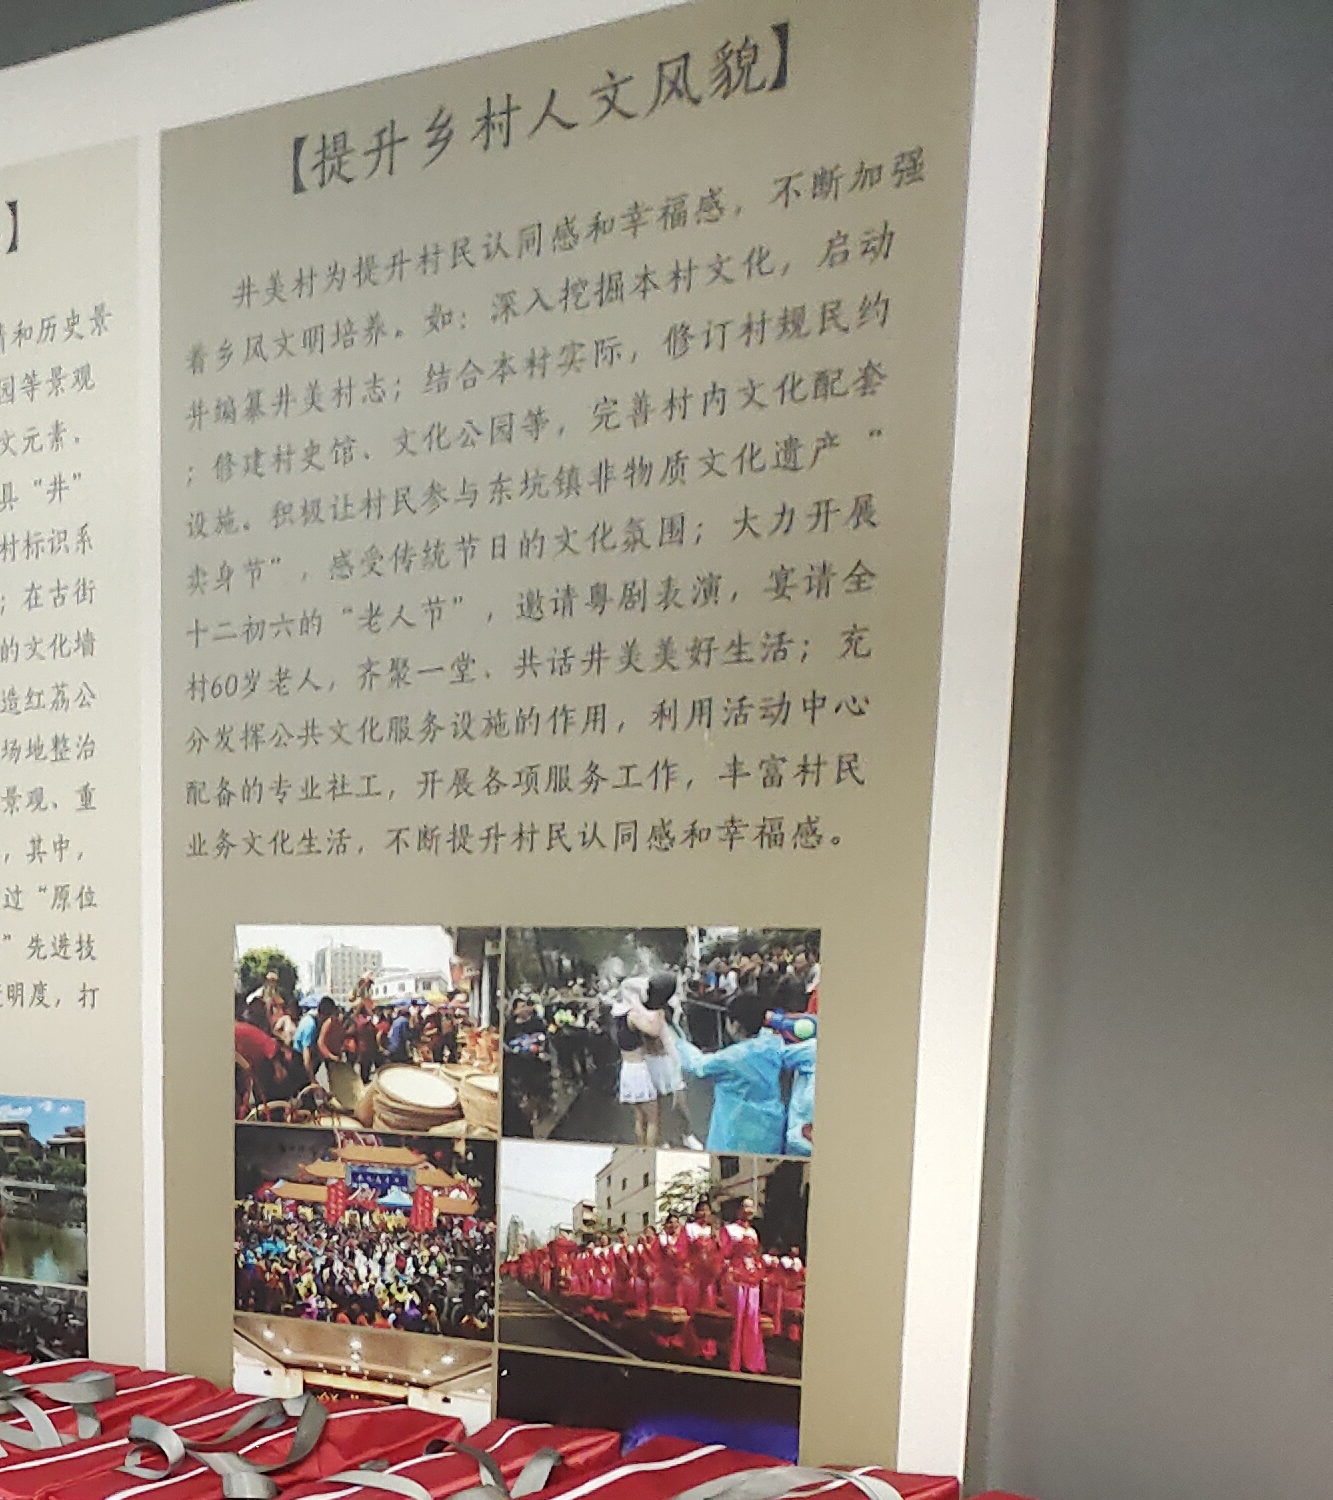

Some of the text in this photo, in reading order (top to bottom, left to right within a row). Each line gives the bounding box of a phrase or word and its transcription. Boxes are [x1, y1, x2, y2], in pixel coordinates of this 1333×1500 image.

[290, 21, 792, 195] 【提升乡村人文风貌】
[231, 145, 927, 309] 井美村为提升村民认同感和幸福感，不断加强
[185, 688, 871, 755] 分发挥公共文化服务设施的作用，利用活动中心
[185, 751, 867, 809] 配备的专业社工，开展各项服务工作，丰富村民
[185, 814, 844, 859] 业务文化生活，不断提升村民认同感和幸福感。
